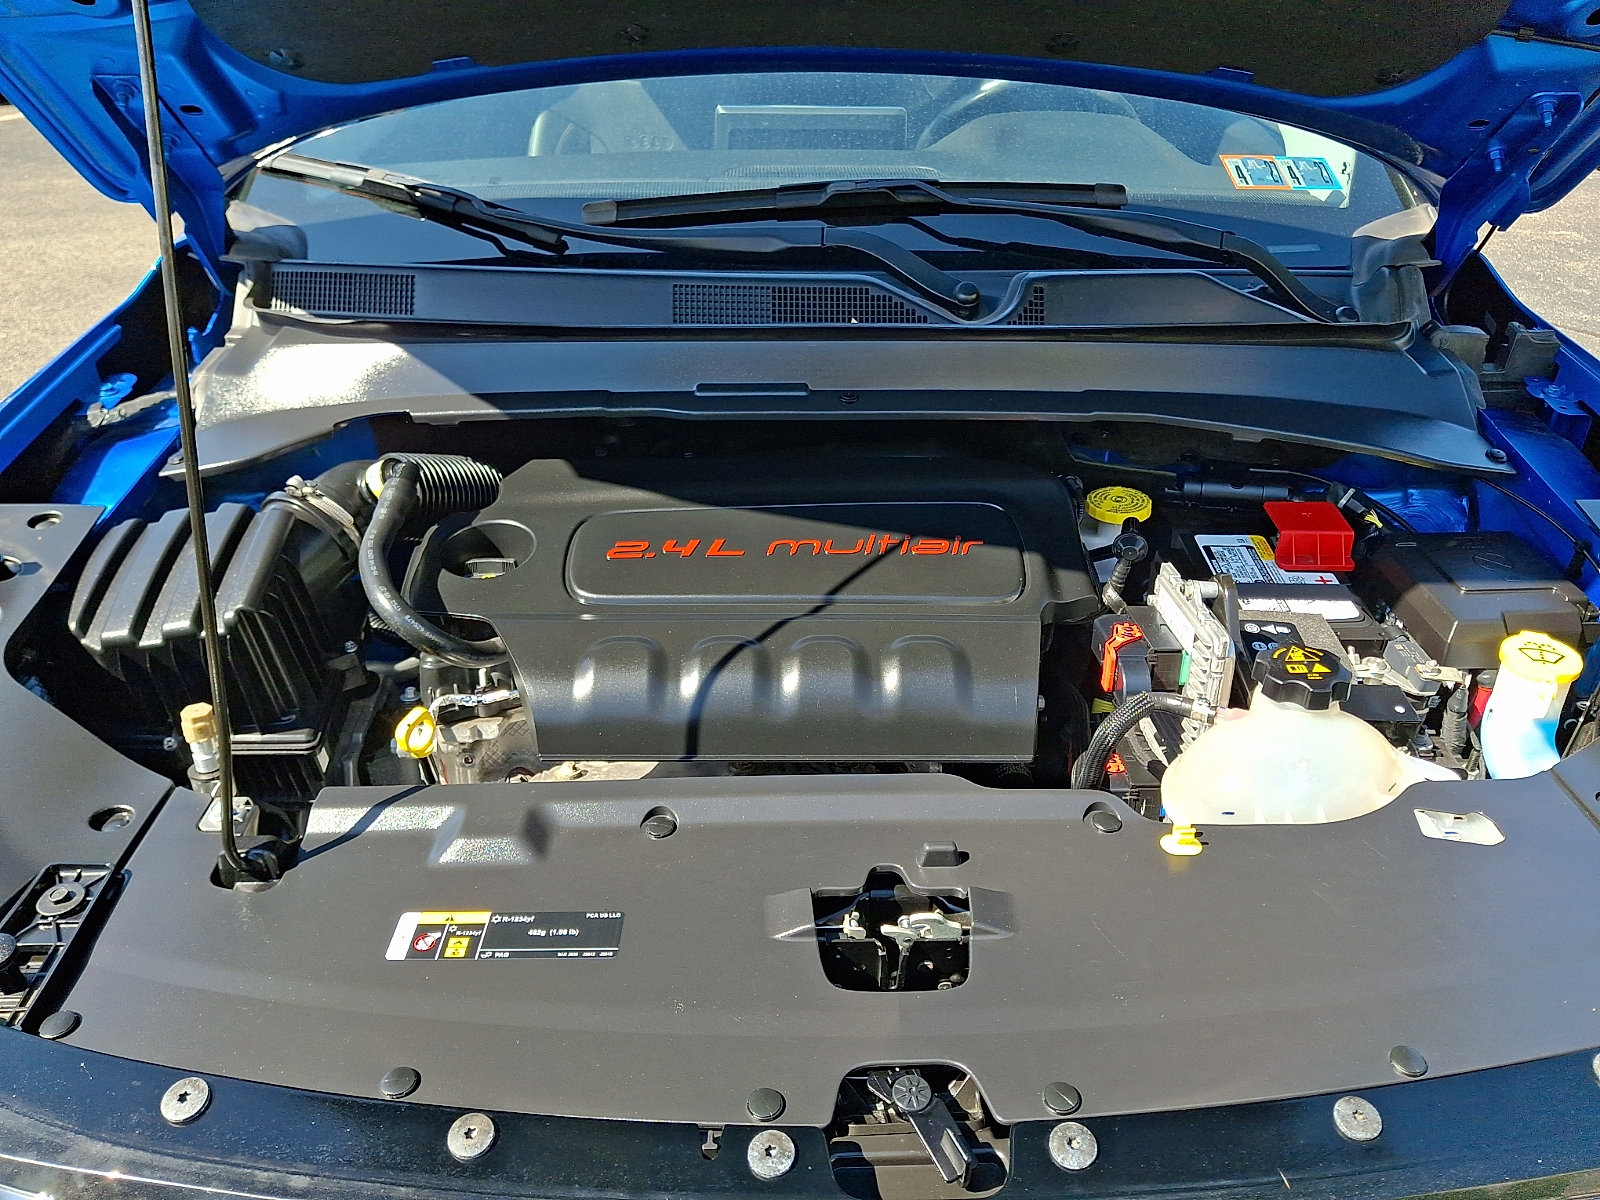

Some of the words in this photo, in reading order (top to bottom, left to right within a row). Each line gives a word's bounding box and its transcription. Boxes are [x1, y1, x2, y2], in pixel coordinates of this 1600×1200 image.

[1234, 164, 1250, 186] 4
[1286, 164, 1302, 186] 4
[766, 533, 984, 557] multiair
[502, 915, 536, 924] R-1234yf
